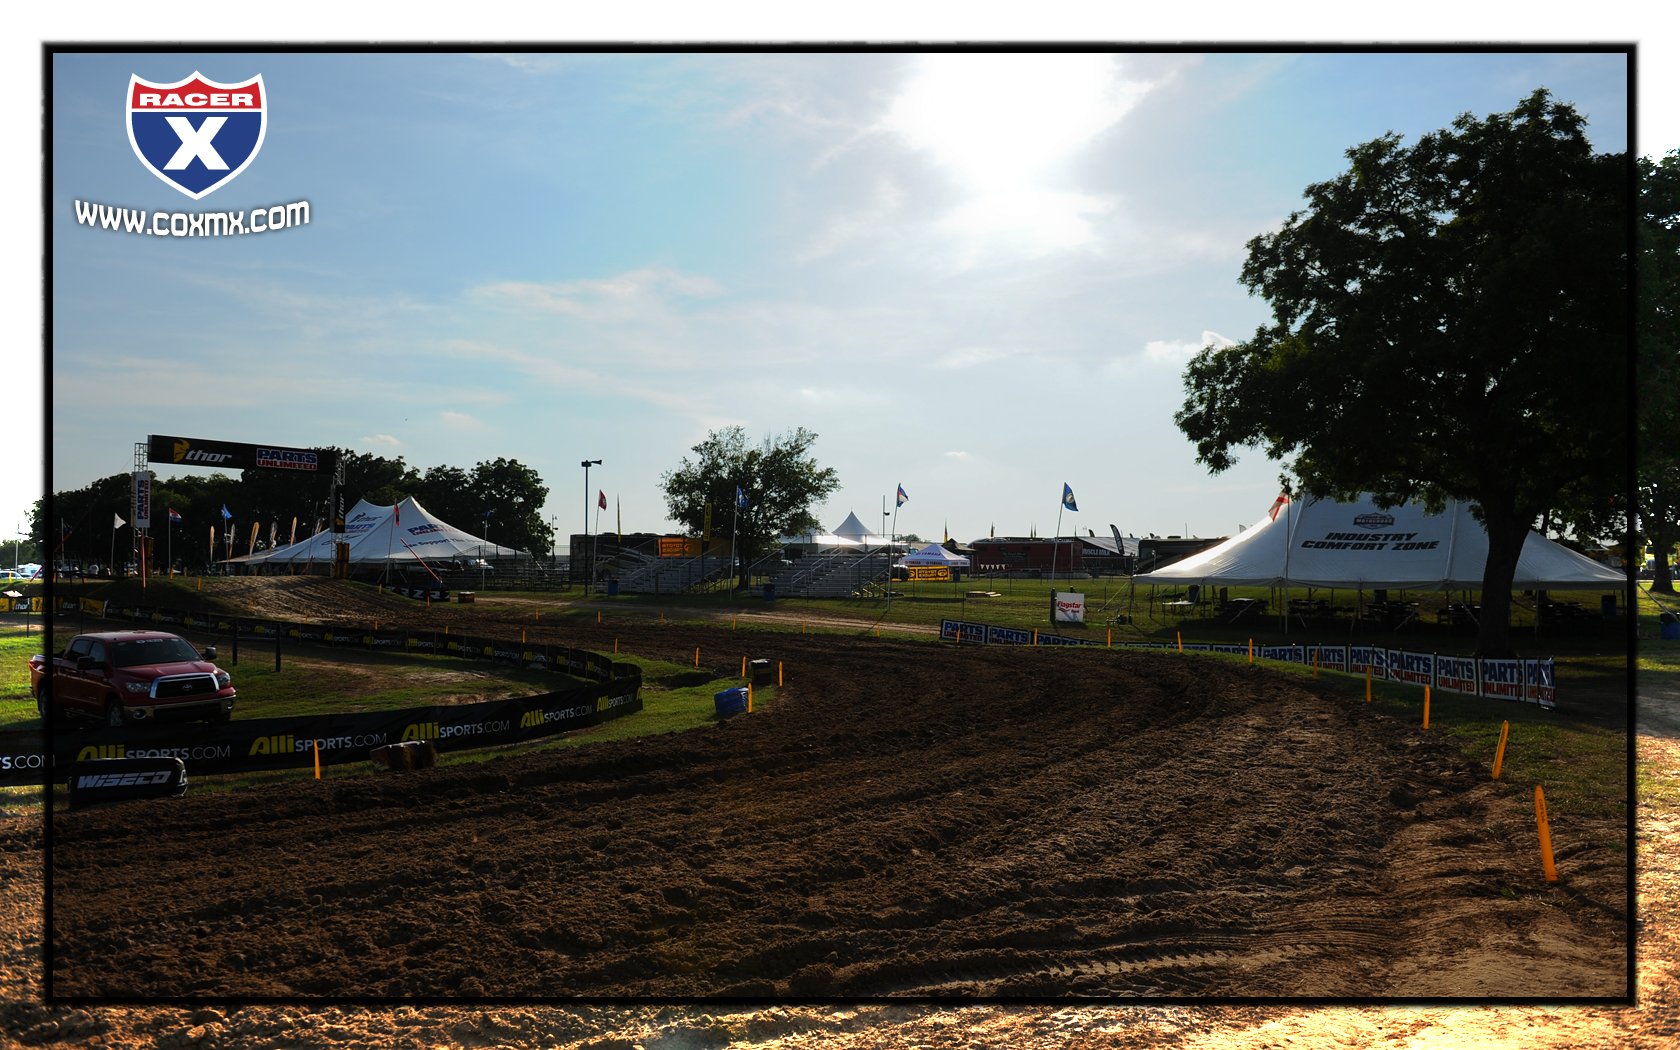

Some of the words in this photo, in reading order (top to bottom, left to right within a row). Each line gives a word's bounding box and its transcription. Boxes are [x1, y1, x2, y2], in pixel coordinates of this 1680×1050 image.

[186, 449, 232, 463] thor
[257, 449, 317, 464] PARTS
[257, 459, 317, 471] UNLIMITED
[137, 479, 145, 520] PARTS
[1325, 532, 1418, 541] INDUSTRY
[1301, 540, 1388, 551] COMFORT
[1392, 540, 1440, 551] ZONE
[1057, 600, 1081, 609] Flagstar
[945, 622, 983, 635] PARTS
[991, 627, 1028, 643] PARTS
[1390, 652, 1432, 673] PARTS
[1438, 659, 1474, 679] PARTS
[1438, 676, 1475, 692] UNLIMITED
[77, 770, 172, 789] WISECO
